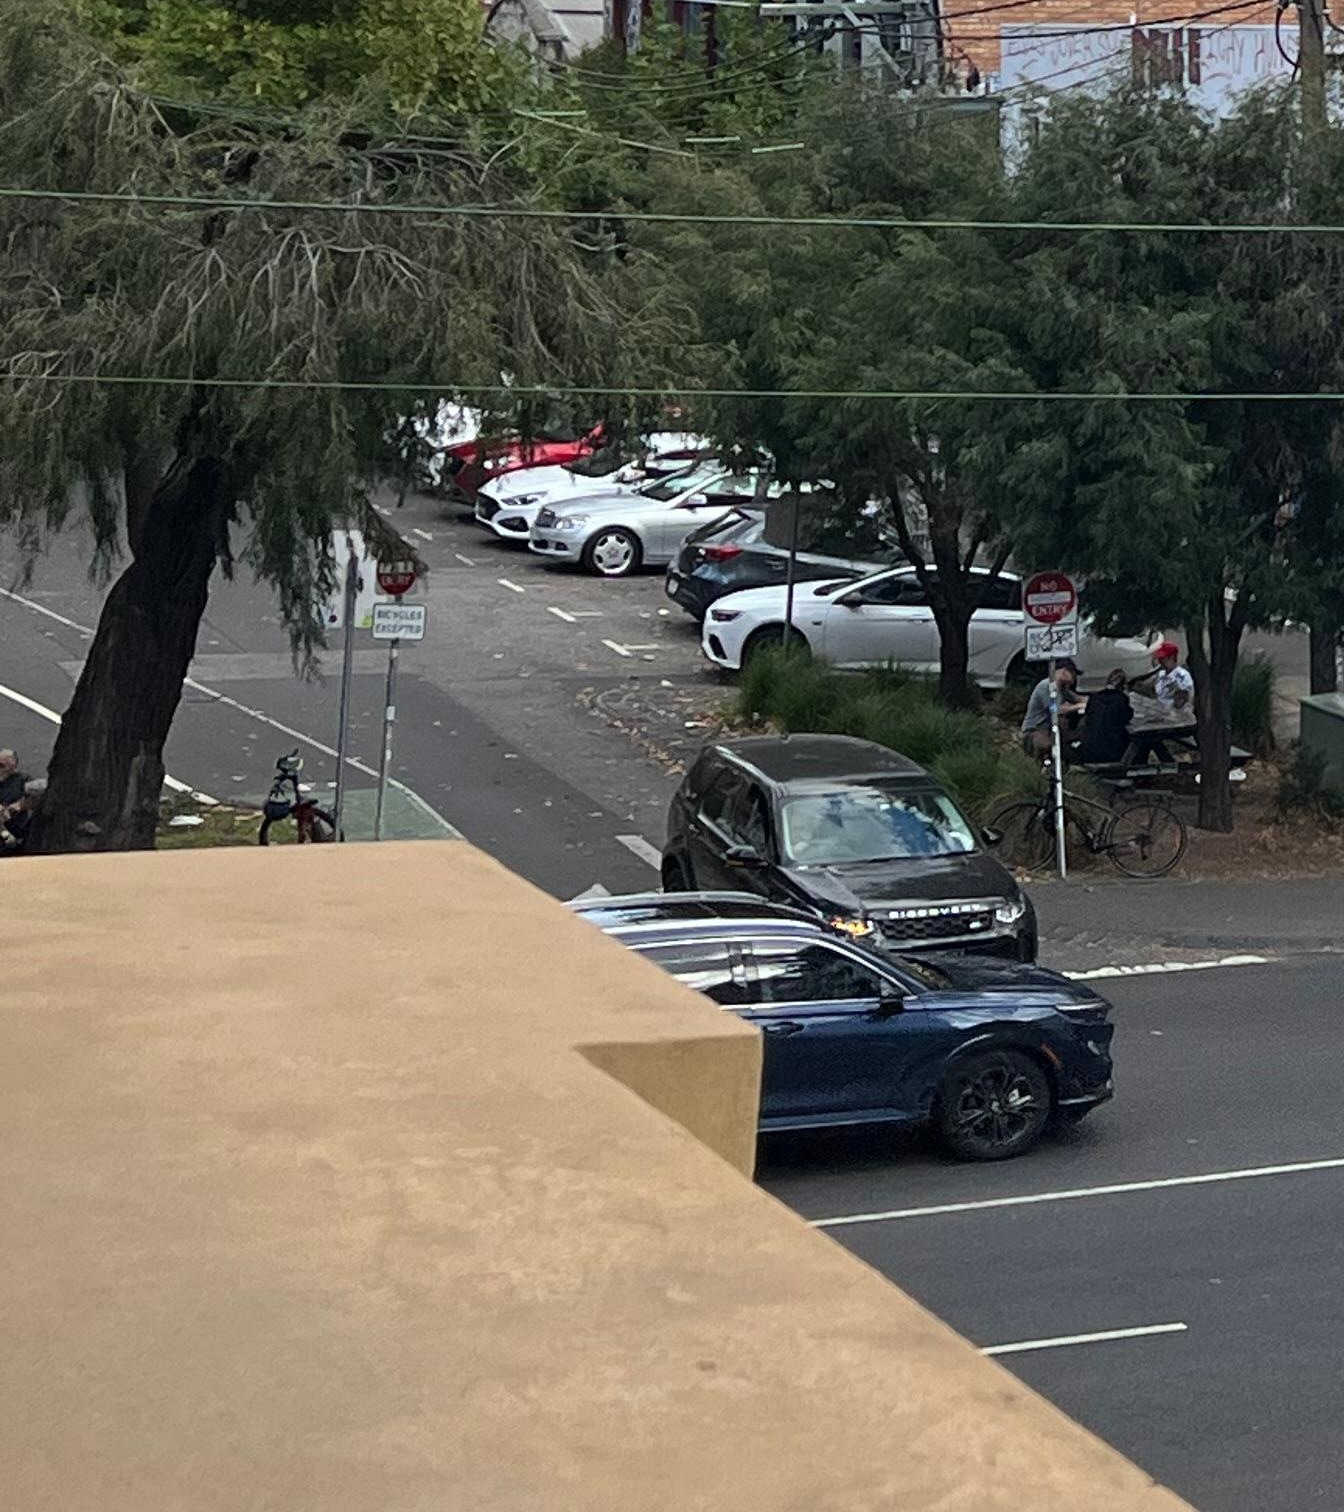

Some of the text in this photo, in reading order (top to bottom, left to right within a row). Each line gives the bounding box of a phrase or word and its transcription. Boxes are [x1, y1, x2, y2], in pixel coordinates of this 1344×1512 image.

[1040, 579, 1058, 592] NO
[377, 610, 422, 620] BICYCLES
[1032, 604, 1068, 617] ENTRY
